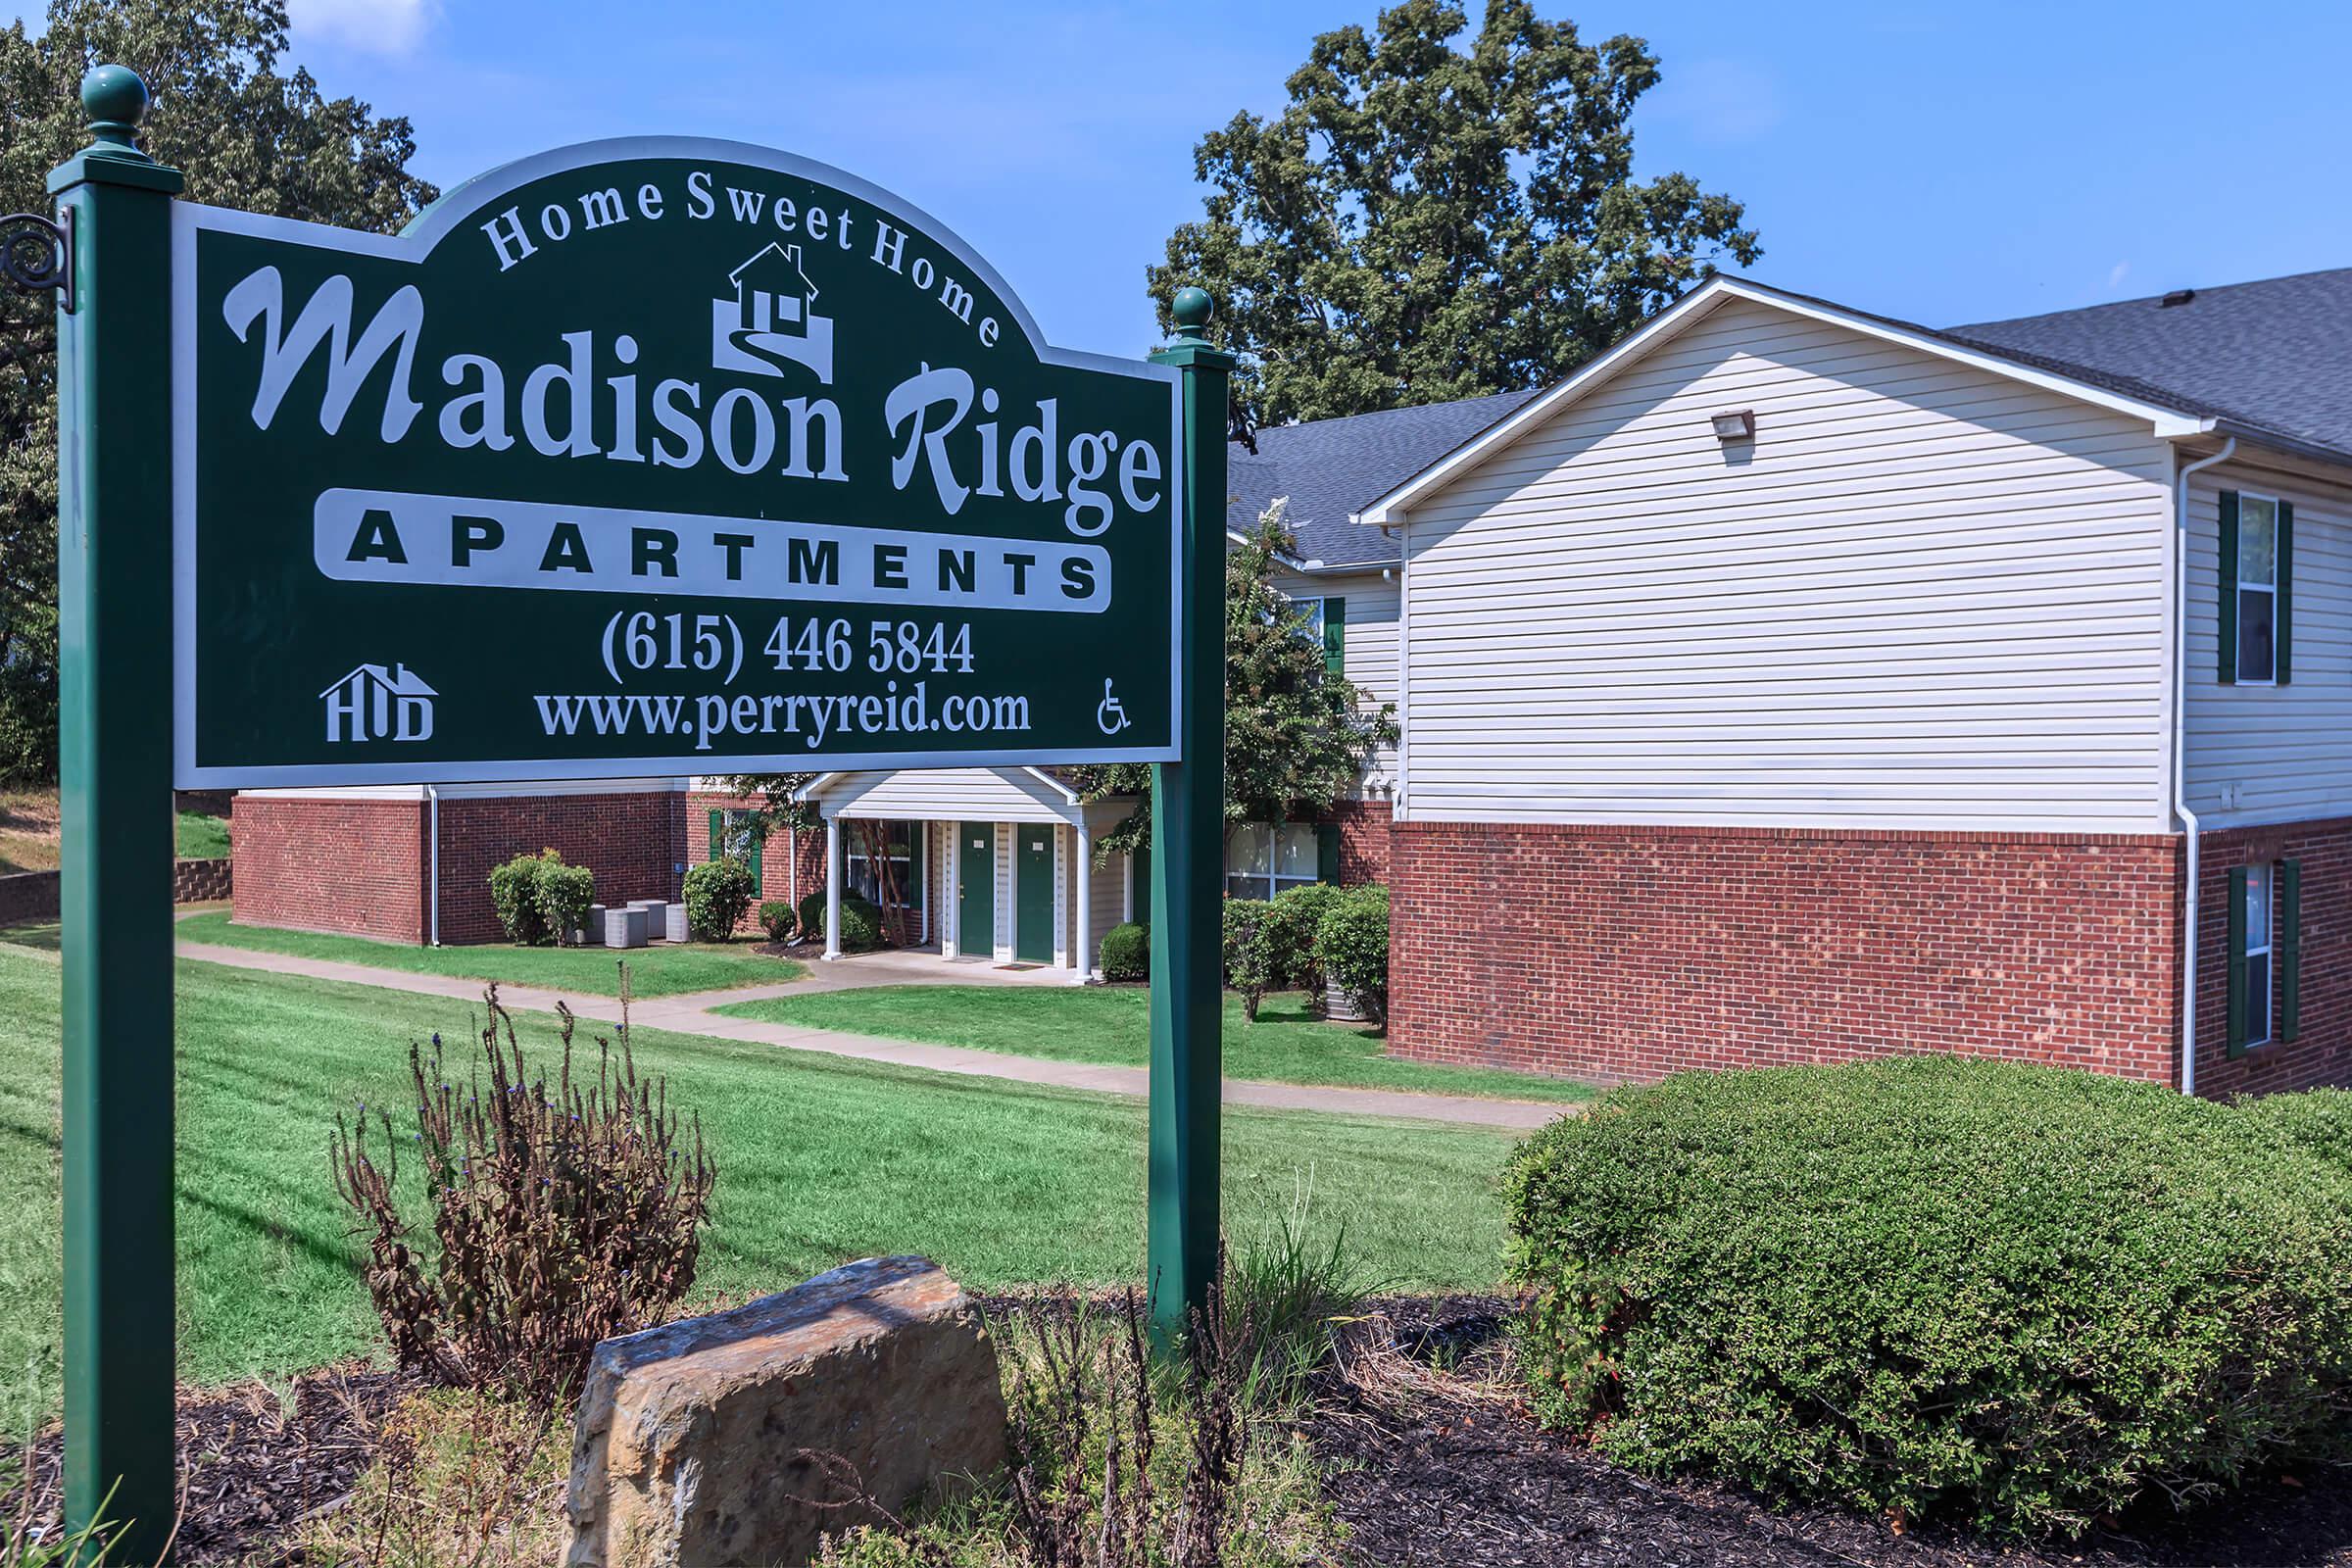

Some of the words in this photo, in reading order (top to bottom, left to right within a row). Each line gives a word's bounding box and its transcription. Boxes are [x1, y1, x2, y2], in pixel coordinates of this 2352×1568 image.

[480, 183, 664, 271] Home
[688, 171, 854, 250] Sweet
[869, 219, 1000, 348] Home
[222, 265, 850, 482] Madison
[884, 361, 1161, 537] Ridge
[345, 509, 1097, 600] APARTMENTS
[602, 611, 744, 686] (615)
[763, 616, 853, 672] 446
[868, 620, 975, 673] 5844
[533, 680, 1032, 750] www.perryreid.com
